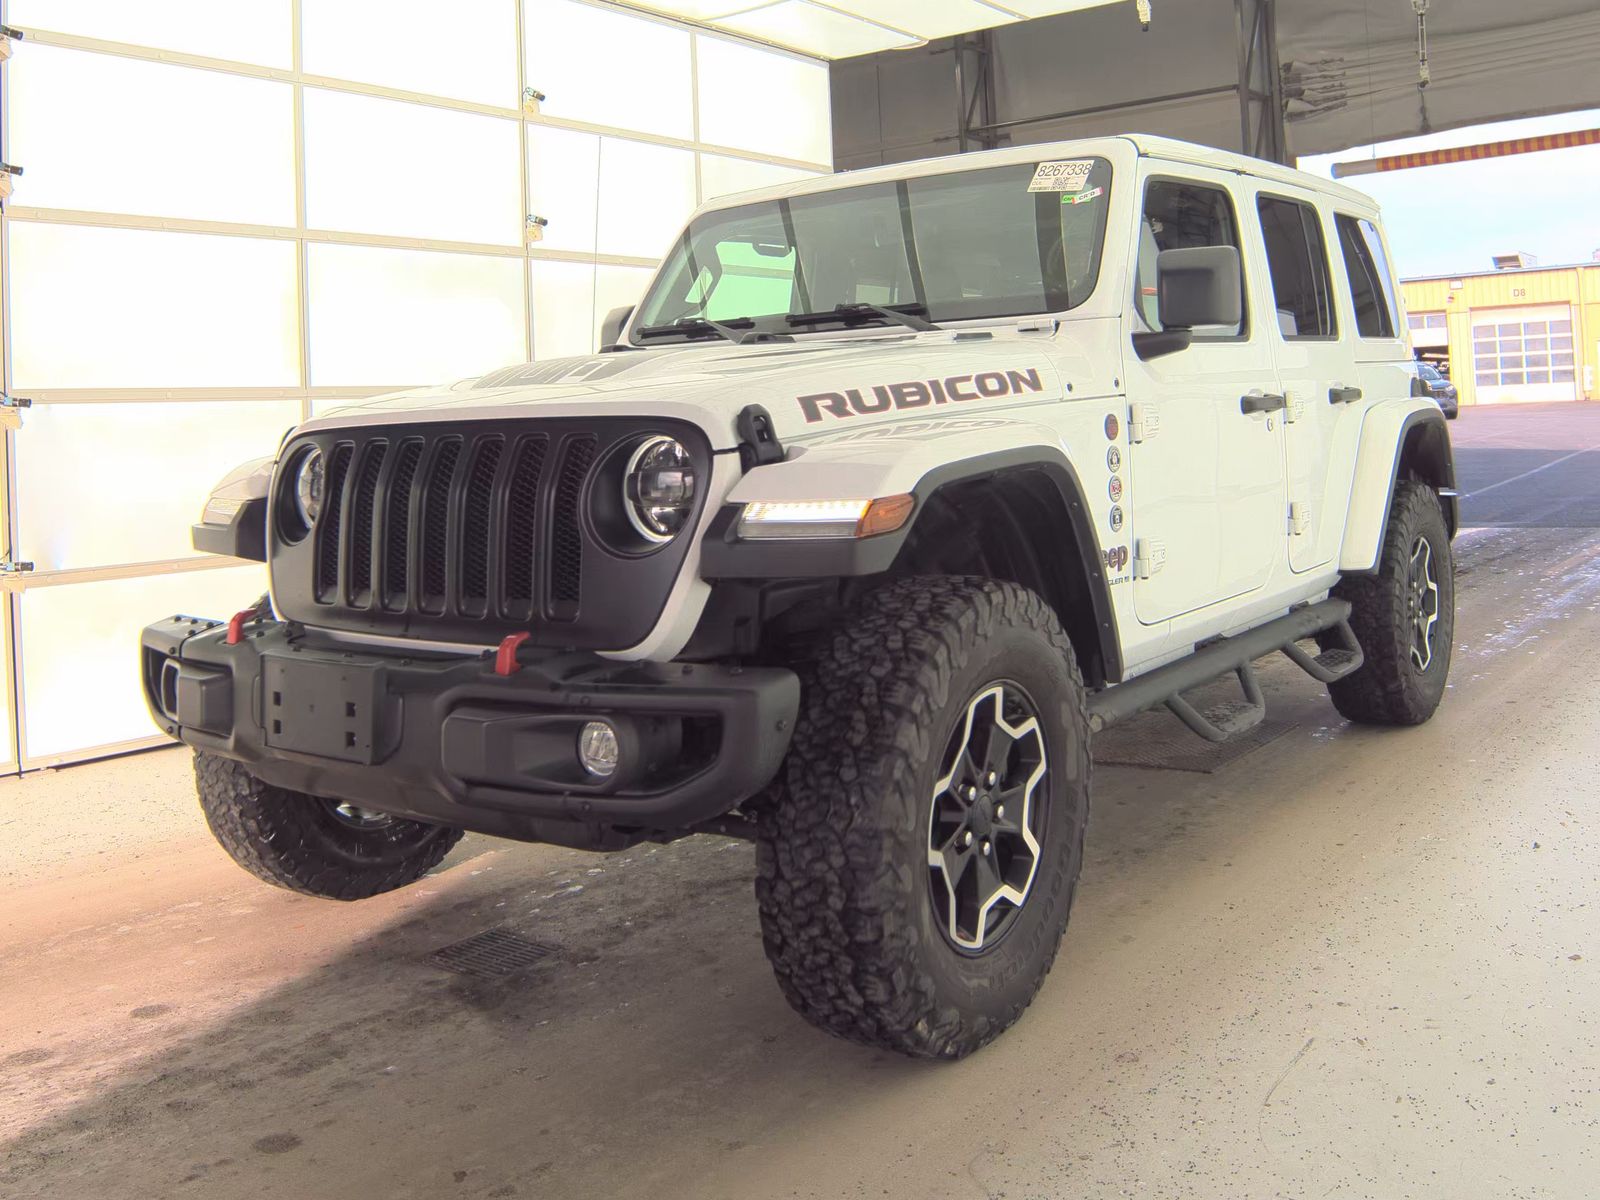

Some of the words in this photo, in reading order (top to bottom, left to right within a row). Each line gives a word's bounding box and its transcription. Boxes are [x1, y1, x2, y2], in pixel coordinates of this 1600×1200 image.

[1038, 164, 1092, 176] 8267338
[797, 368, 1043, 423] RUBICON
[1101, 545, 1128, 572] eep
